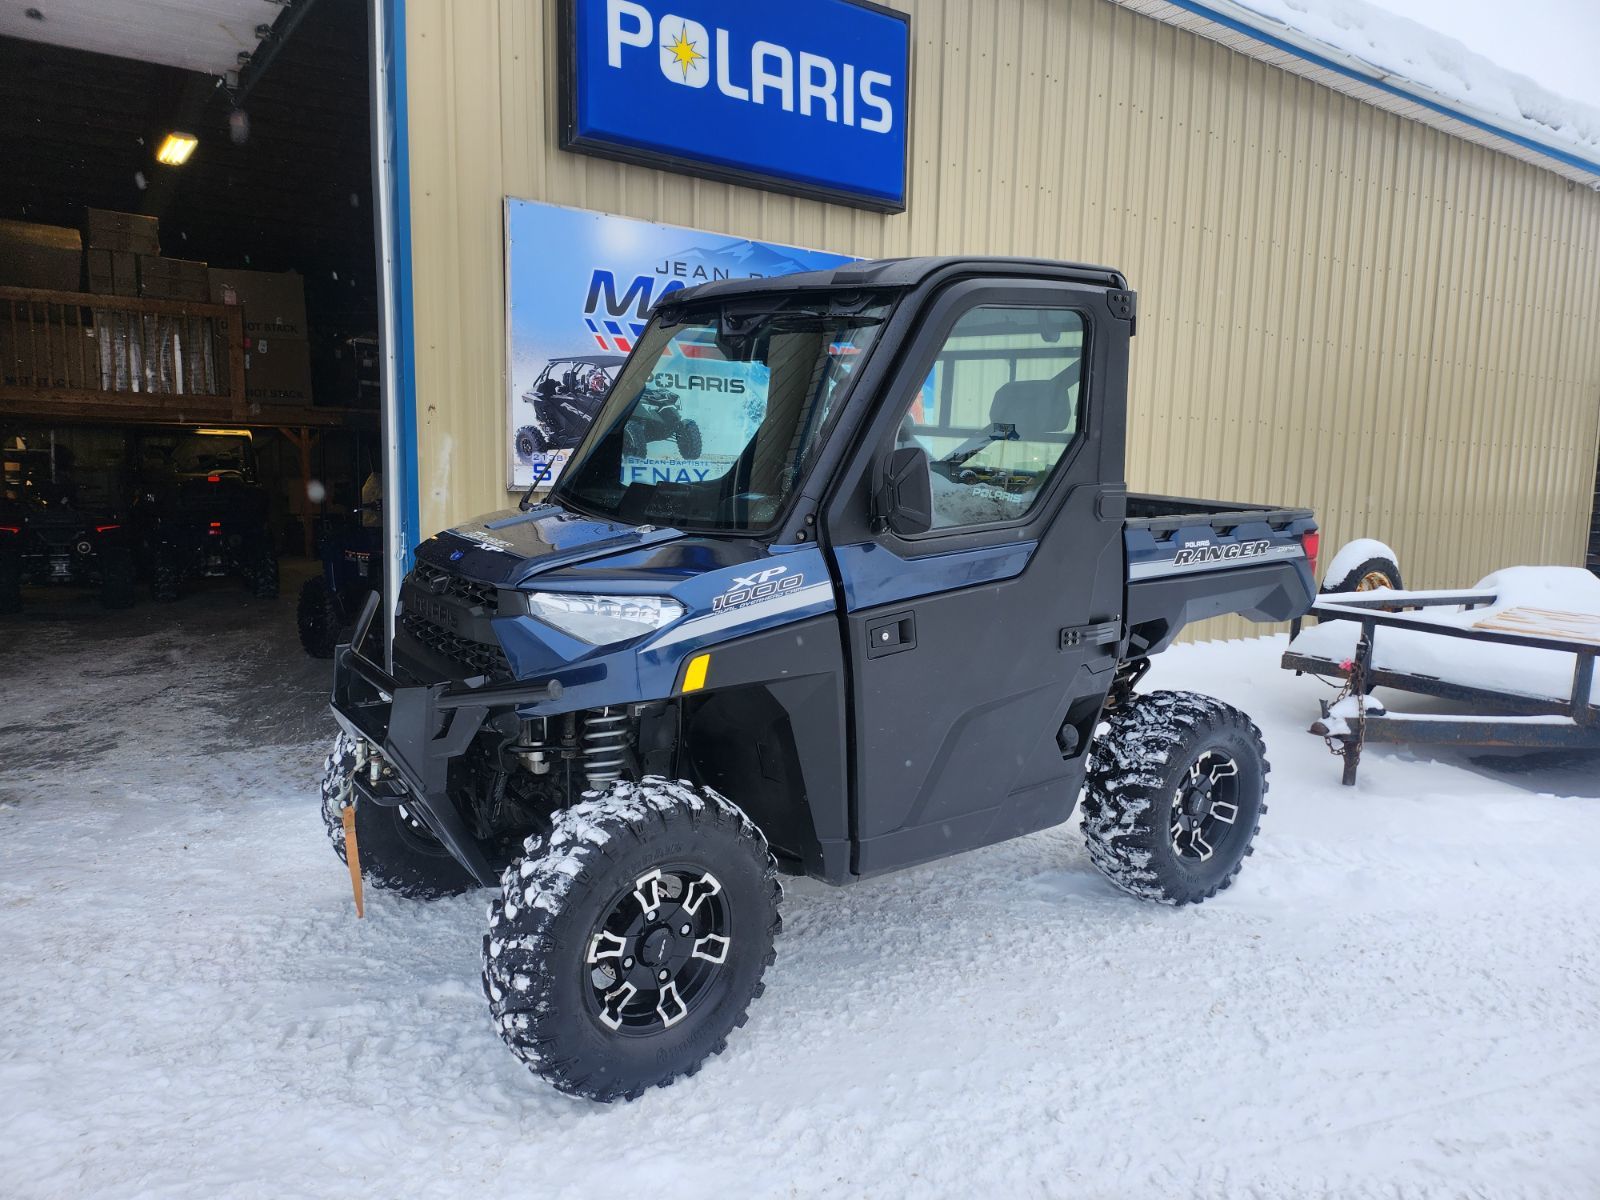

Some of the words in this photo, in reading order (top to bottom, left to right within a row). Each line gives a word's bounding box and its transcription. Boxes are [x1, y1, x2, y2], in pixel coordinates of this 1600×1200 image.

[607, 0, 893, 134] POLARIS
[655, 260, 729, 281] JEAN
[972, 487, 1022, 503] POLARIS
[1173, 540, 1271, 567] RANGER
[1185, 540, 1210, 549] POLARIS
[727, 565, 787, 592] XP
[712, 573, 804, 612] 1000
